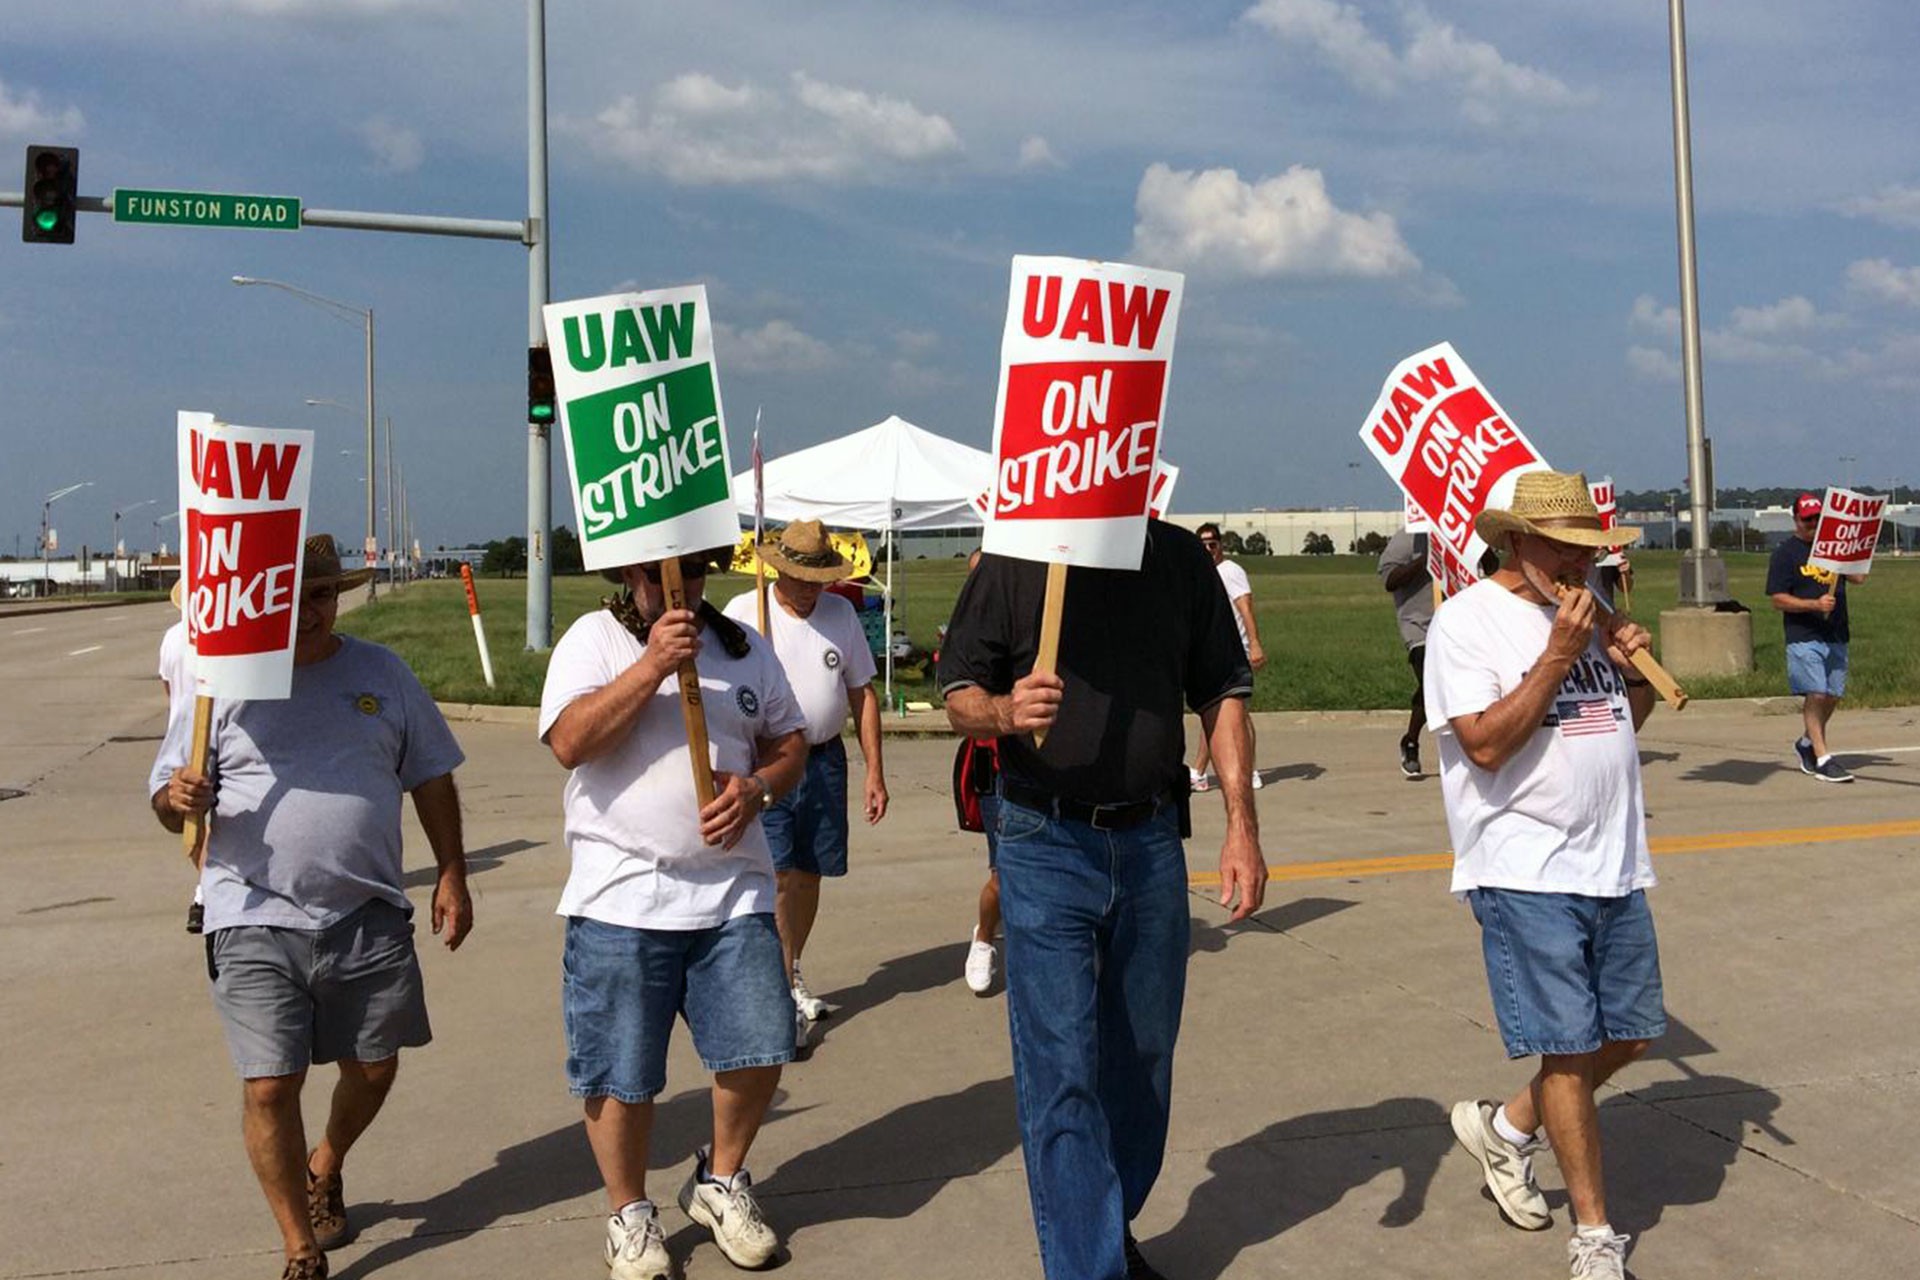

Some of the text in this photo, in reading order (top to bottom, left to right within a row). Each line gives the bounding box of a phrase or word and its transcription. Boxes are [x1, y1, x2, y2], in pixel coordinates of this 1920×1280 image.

[128, 197, 287, 222] FUNSTON ROAD
[563, 301, 696, 373] UAW
[1022, 275, 1171, 351] UAW
[613, 382, 671, 453] ON
[1042, 369, 1112, 436] ON
[1371, 357, 1458, 456] UAW
[581, 415, 723, 534] STRIKE
[997, 420, 1157, 513] STRIKE
[1421, 409, 1460, 478] ON
[1438, 413, 1518, 551] STRIKE
[1830, 493, 1884, 517] UAW
[1814, 534, 1875, 556] STRIKE
[1836, 523, 1862, 541] ON
